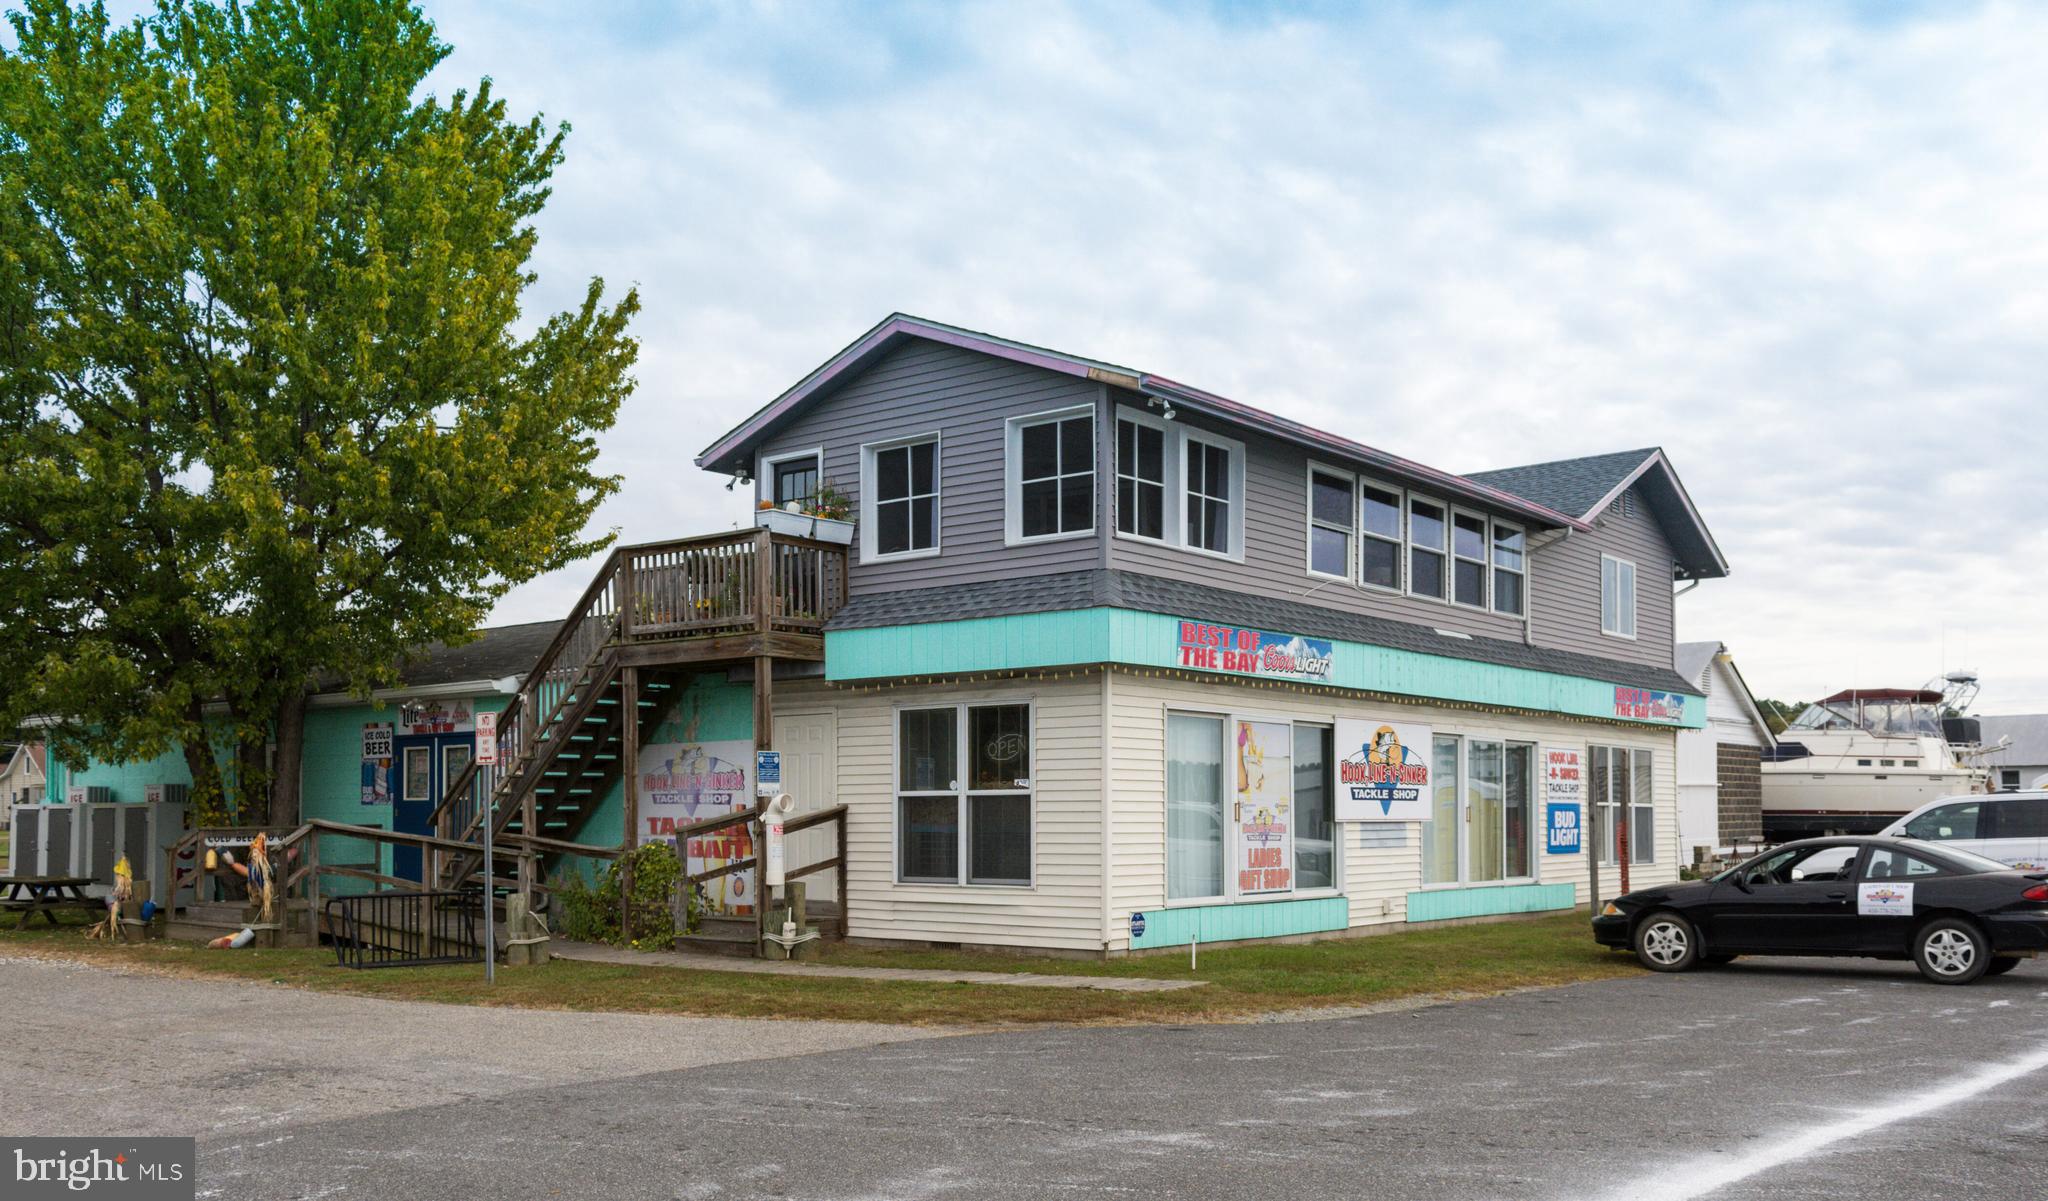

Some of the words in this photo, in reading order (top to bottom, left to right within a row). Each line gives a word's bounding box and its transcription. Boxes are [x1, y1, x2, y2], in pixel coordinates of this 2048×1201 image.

[1181, 622, 1233, 648] BEST
[1237, 629, 1261, 651] OF
[1180, 646, 1218, 669] THE
[1222, 651, 1261, 673] BAY
[1263, 644, 1296, 673] Coors
[1295, 657, 1329, 675] LIGHT
[1615, 687, 1639, 703] BEST
[402, 709, 419, 727] Lite
[1615, 702, 1632, 717] THE
[1634, 704, 1649, 718] BAY
[481, 716, 490, 726] NO
[365, 732, 374, 740] ICE
[375, 731, 391, 740] COLD
[365, 741, 391, 756] BEER
[987, 737, 1026, 758] OPEN
[1353, 789, 1389, 799] TACKLE
[1393, 790, 1417, 800] SHOP
[1549, 783, 1568, 794] TACKLE
[70, 794, 83, 803] ICE
[147, 792, 160, 803] ICE
[656, 794, 695, 804] TACKLE
[700, 794, 729, 804] SHOP
[1554, 811, 1576, 829] BUD
[1550, 828, 1579, 846] LIGHT
[687, 840, 743, 859] BAIT
[1248, 847, 1282, 868] LADIES
[1240, 869, 1262, 890] GIFT
[1264, 868, 1290, 889] SHOP
